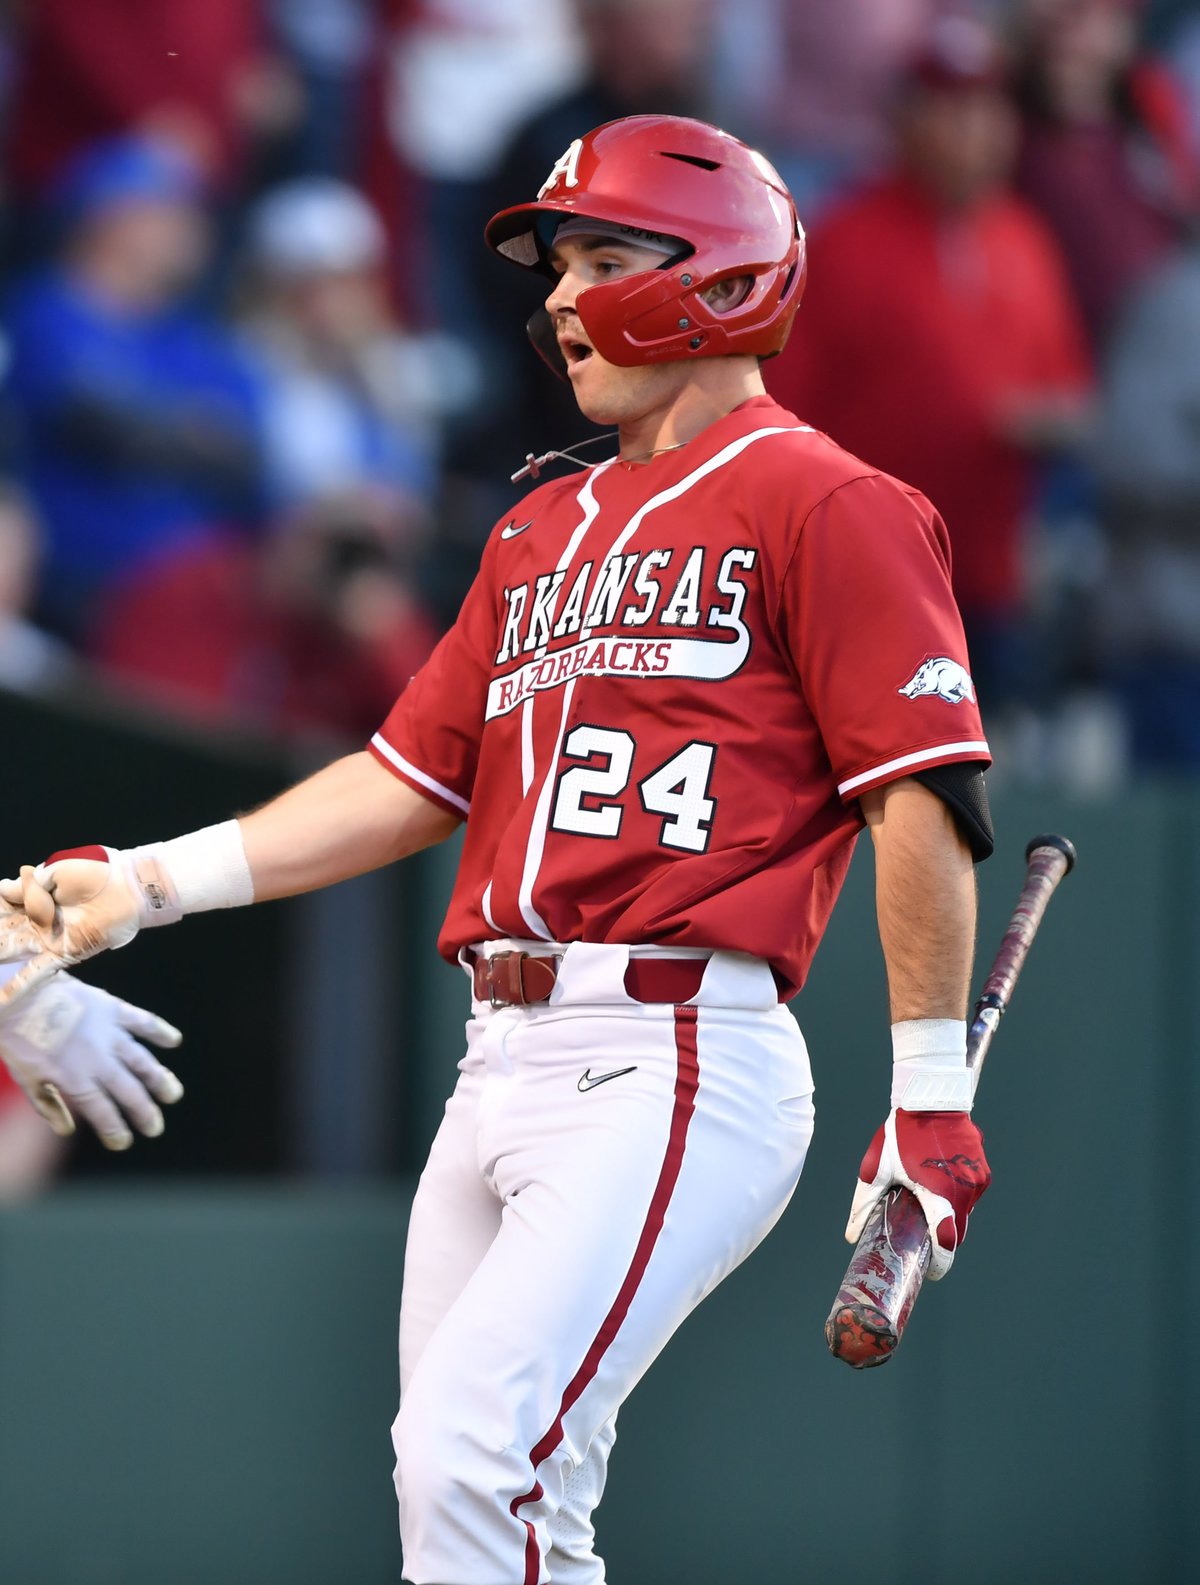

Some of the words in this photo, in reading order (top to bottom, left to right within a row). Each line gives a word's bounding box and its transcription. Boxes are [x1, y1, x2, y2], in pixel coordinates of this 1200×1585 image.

[536, 138, 583, 202] A
[495, 546, 759, 667] RKANSAS
[497, 641, 672, 711] RAZORBACKS
[550, 721, 719, 855] 24
